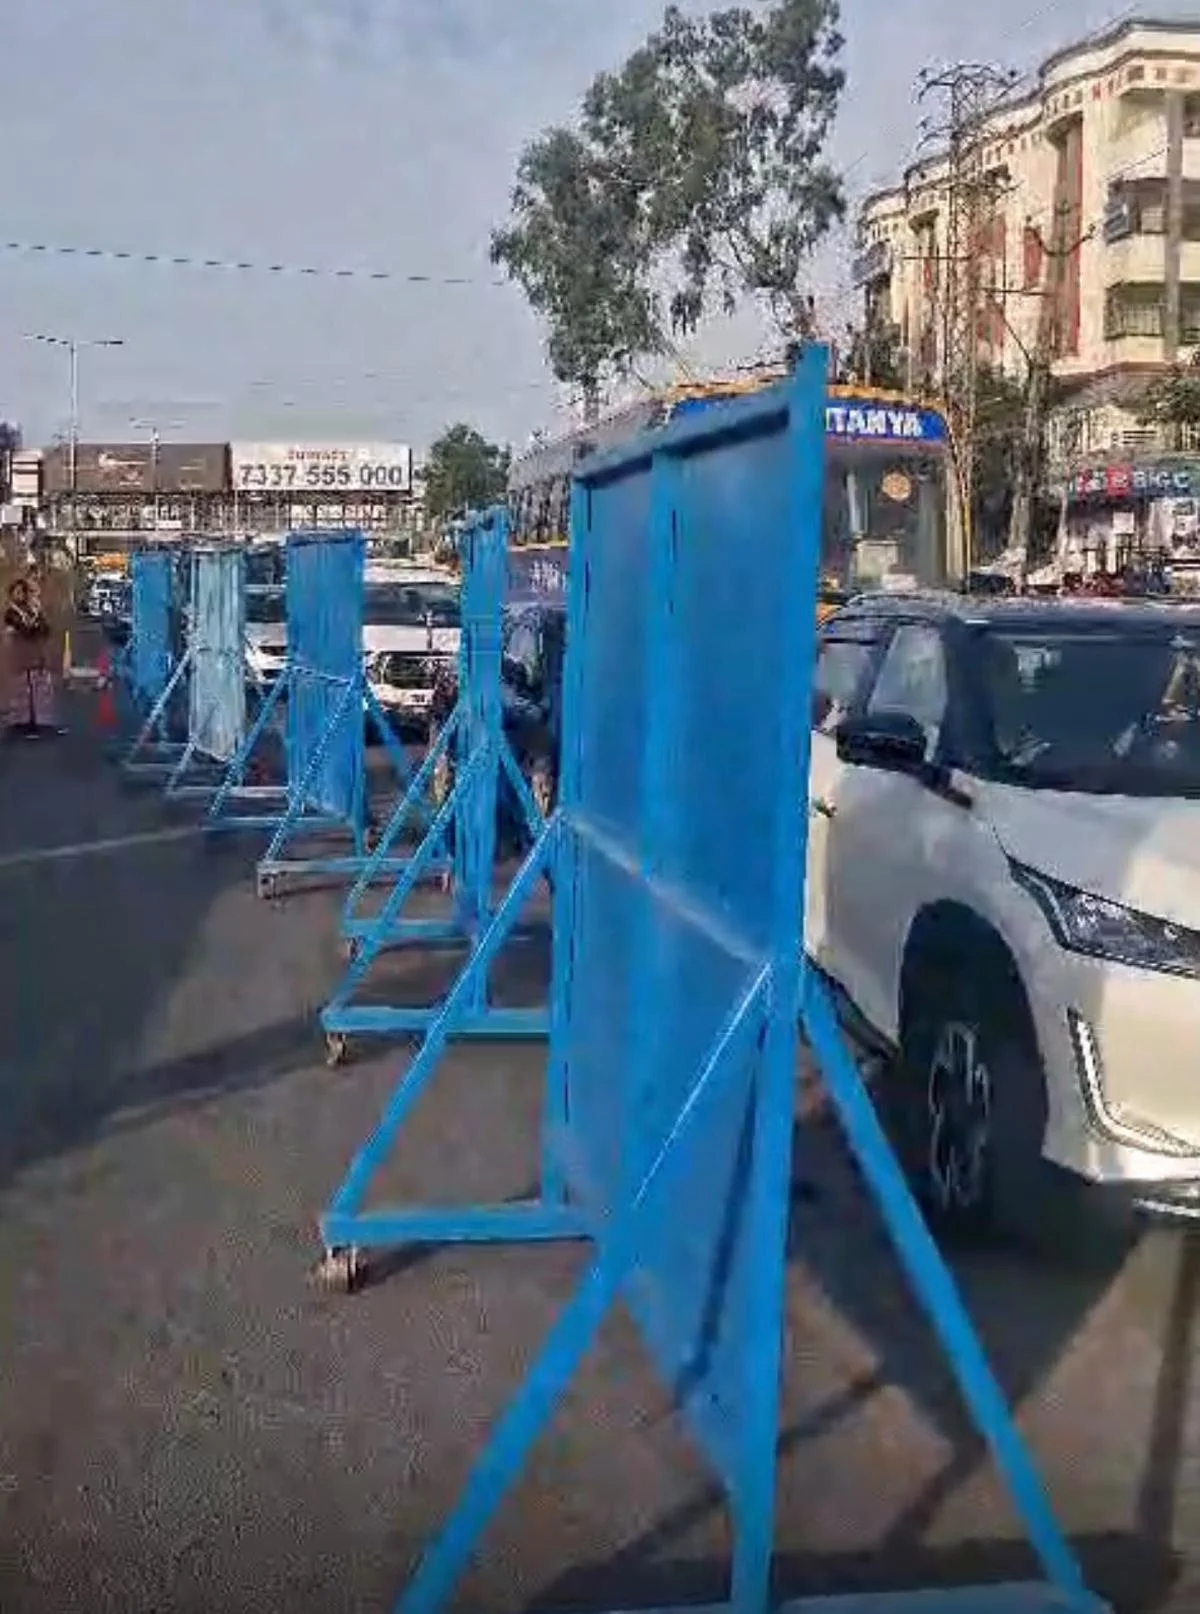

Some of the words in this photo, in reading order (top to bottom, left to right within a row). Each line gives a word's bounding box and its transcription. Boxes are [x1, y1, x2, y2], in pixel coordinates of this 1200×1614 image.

[240, 464, 298, 486] 7337
[305, 464, 350, 486] 555
[359, 463, 402, 486] 000
